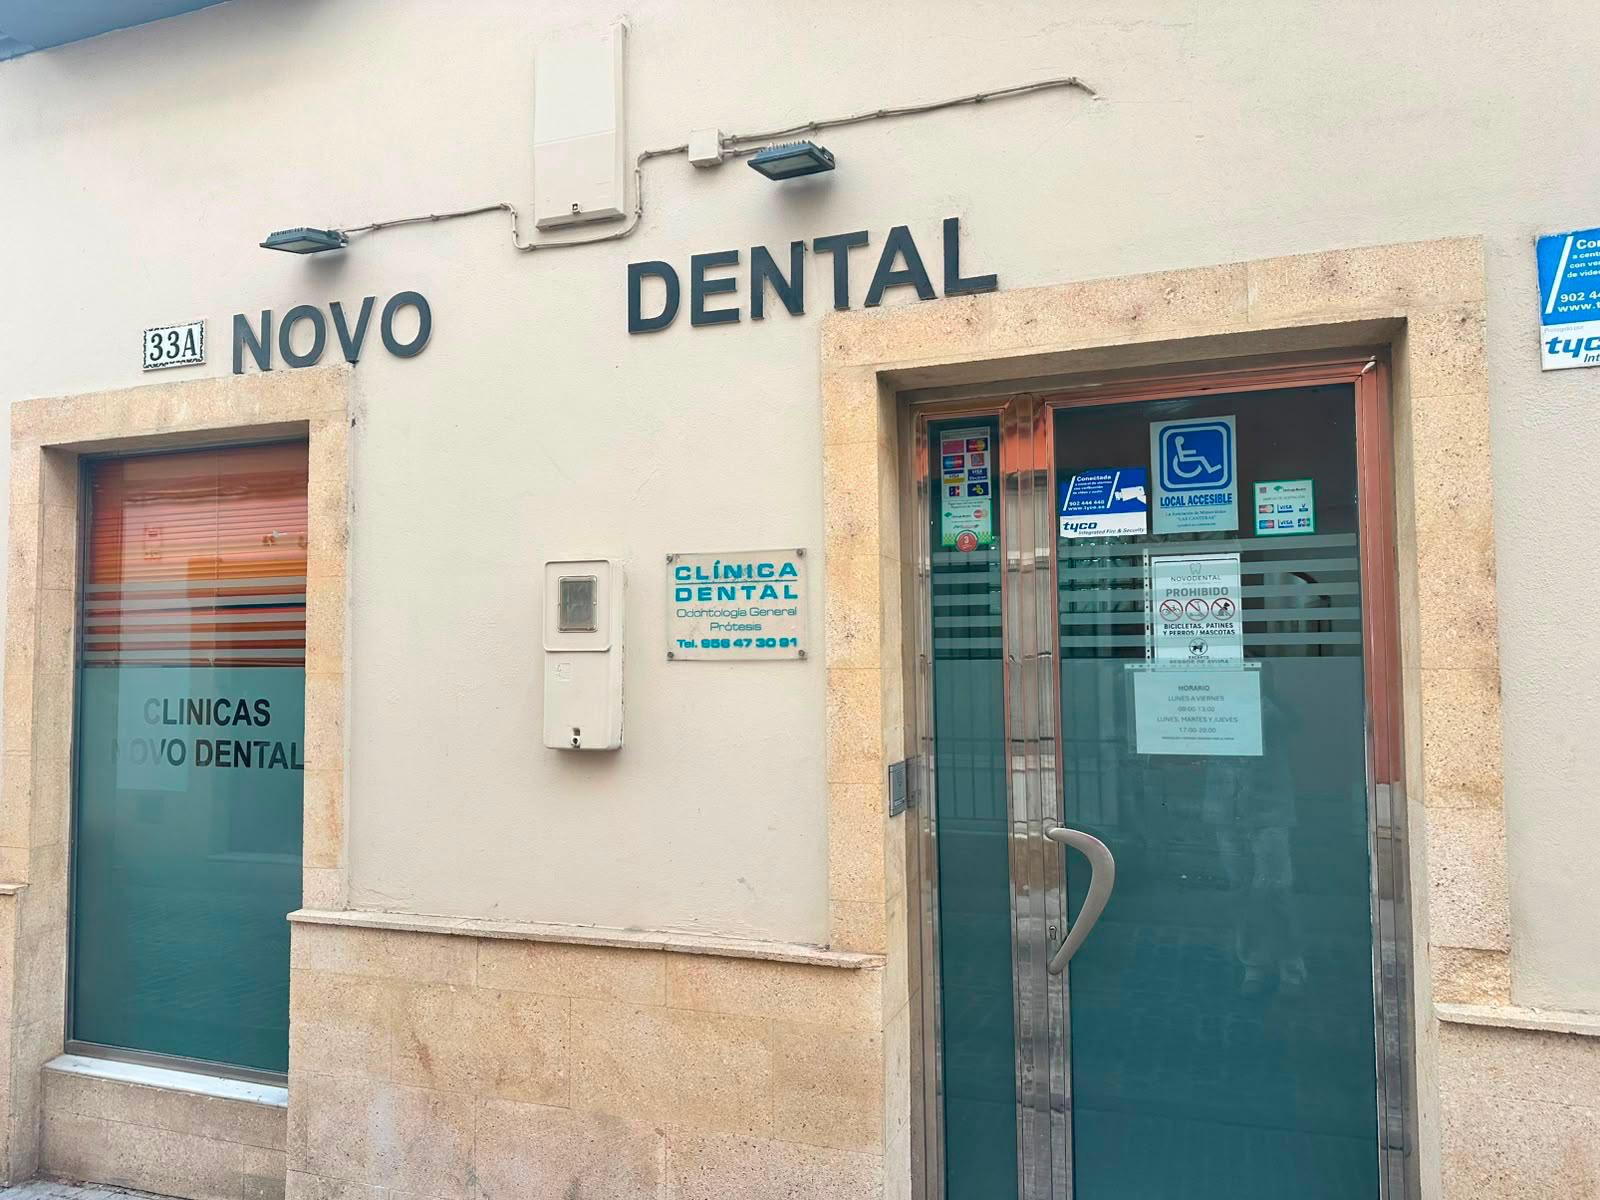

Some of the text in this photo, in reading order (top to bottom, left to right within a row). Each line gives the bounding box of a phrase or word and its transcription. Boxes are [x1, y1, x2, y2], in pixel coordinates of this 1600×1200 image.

[232, 217, 998, 375] NOVO DENTAL
[1560, 290, 1600, 303] 902 4
[149, 328, 201, 362] 33A
[1076, 474, 1112, 482] Conectada
[1160, 493, 1233, 507] LOCAL ACCESIBLE
[1063, 521, 1098, 532] tyco
[674, 559, 798, 581] CLÍNICA
[674, 584, 799, 603] DENTAL
[1166, 587, 1229, 598] PROHIBIDO
[749, 606, 798, 617] General
[709, 621, 762, 633] Prótesis
[676, 639, 698, 649] Tel.
[700, 638, 731, 649] 956
[733, 638, 753, 648] 47
[755, 638, 776, 648] 30
[143, 698, 271, 727] CLINICAS
[195, 739, 304, 770] DENTAL
